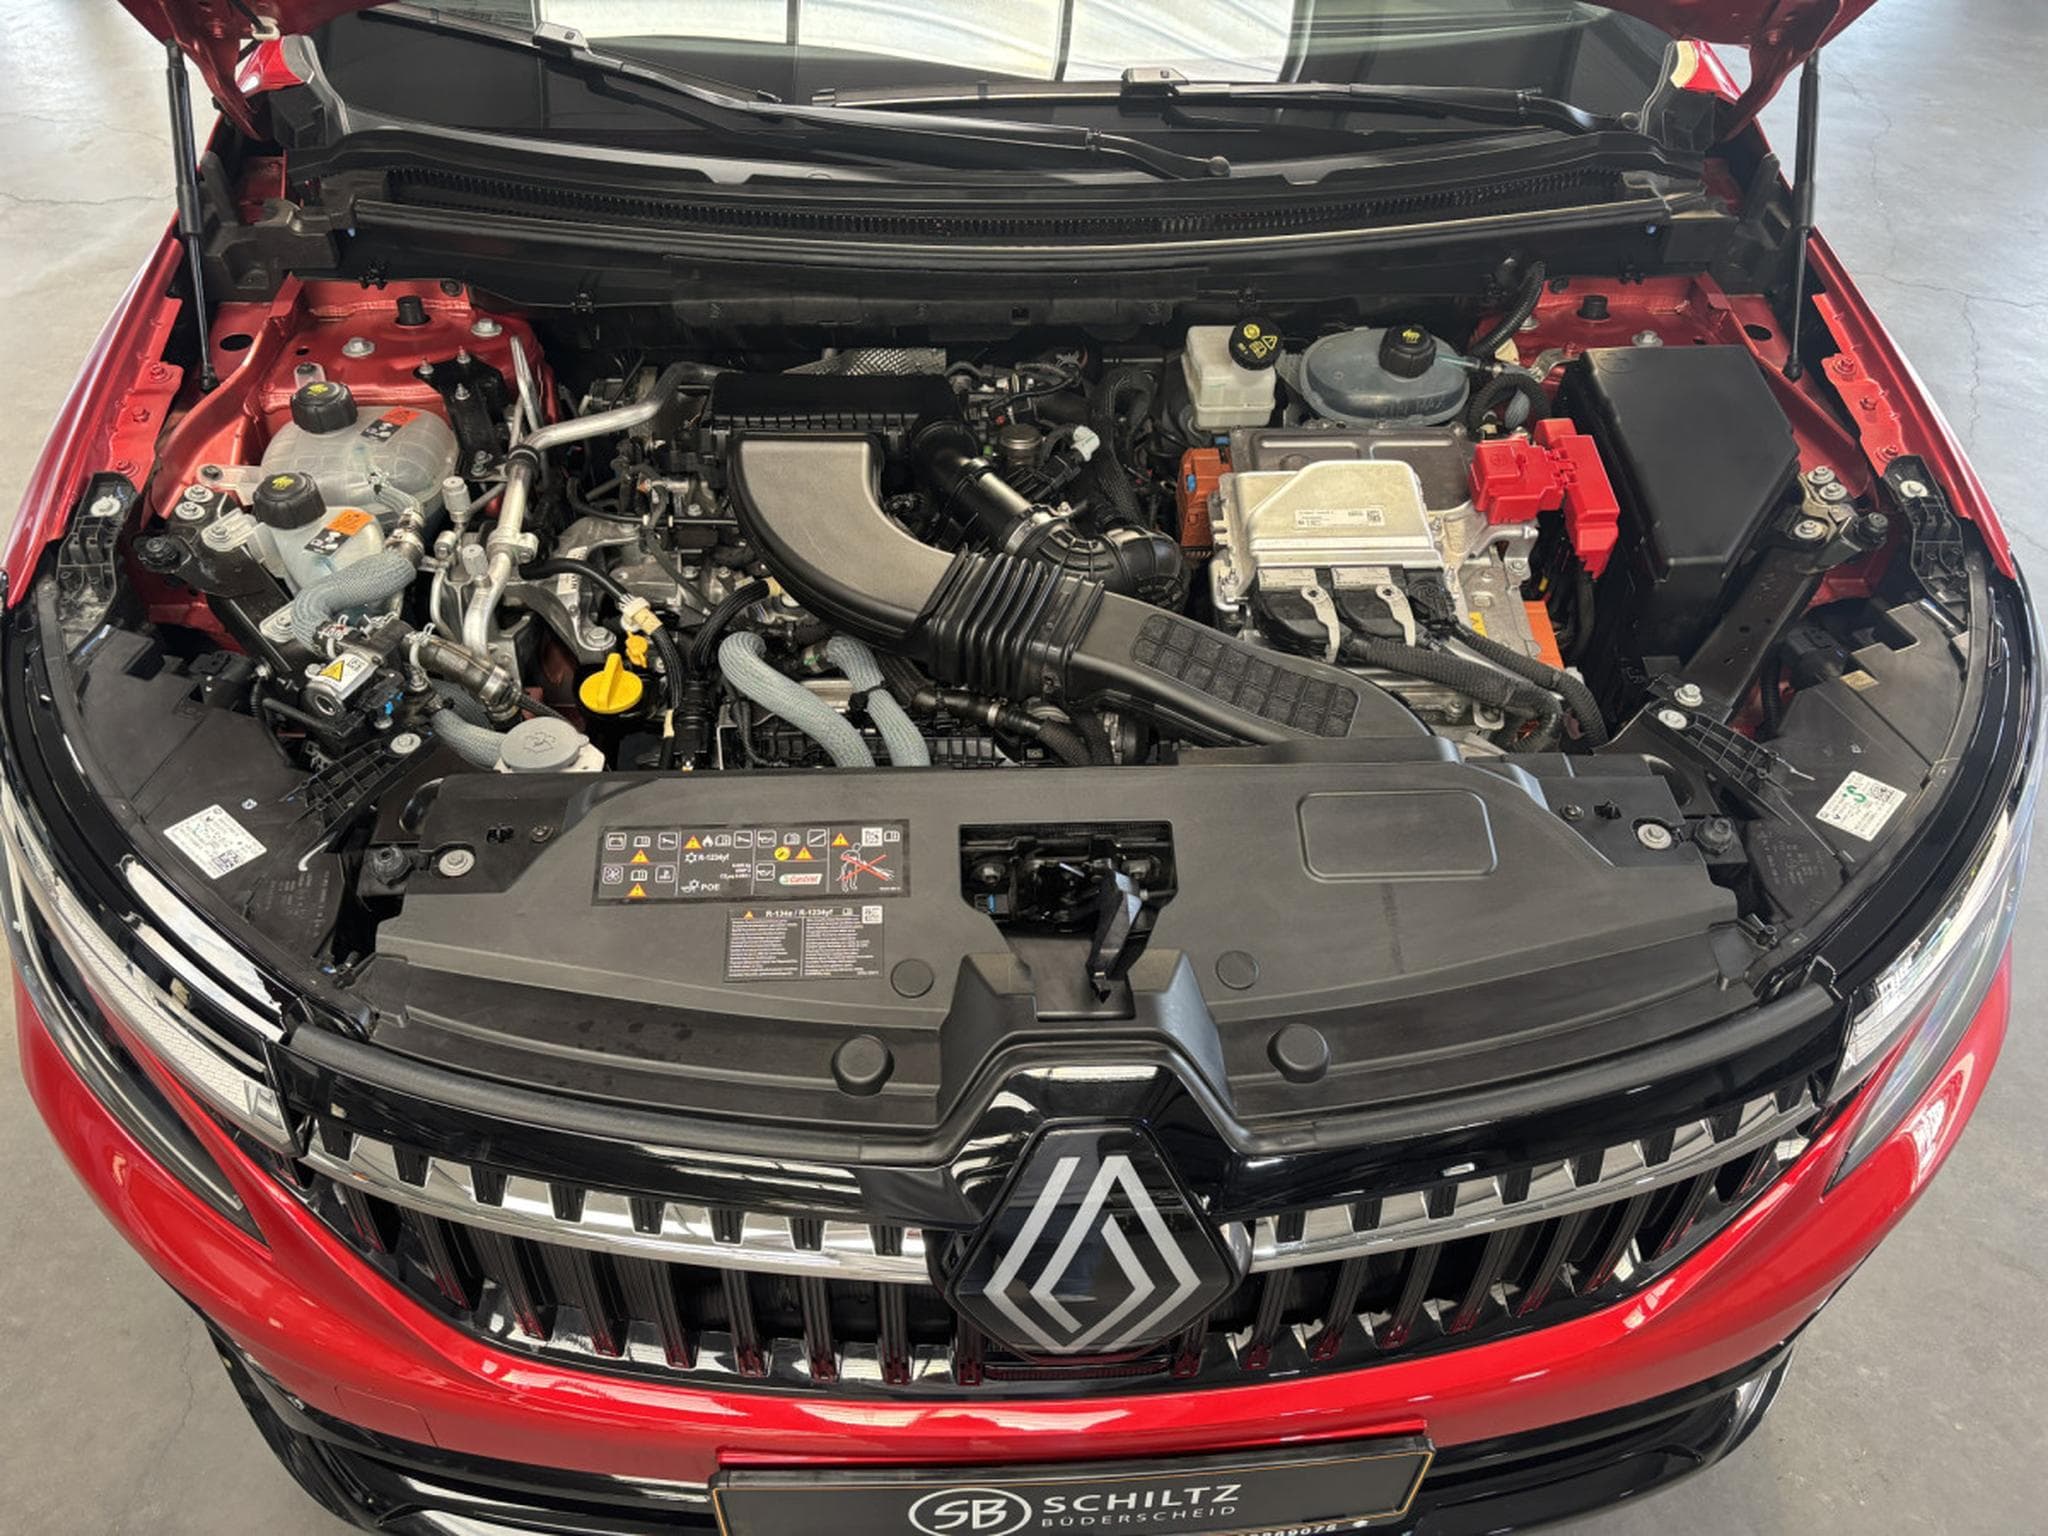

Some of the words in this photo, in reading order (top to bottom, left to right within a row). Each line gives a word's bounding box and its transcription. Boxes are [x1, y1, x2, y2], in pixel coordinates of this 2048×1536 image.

[1043, 1484, 1242, 1513] SCHILTZ
[934, 1499, 1007, 1530] SB
[1042, 1506, 1236, 1527] BÜDERSCHEID
